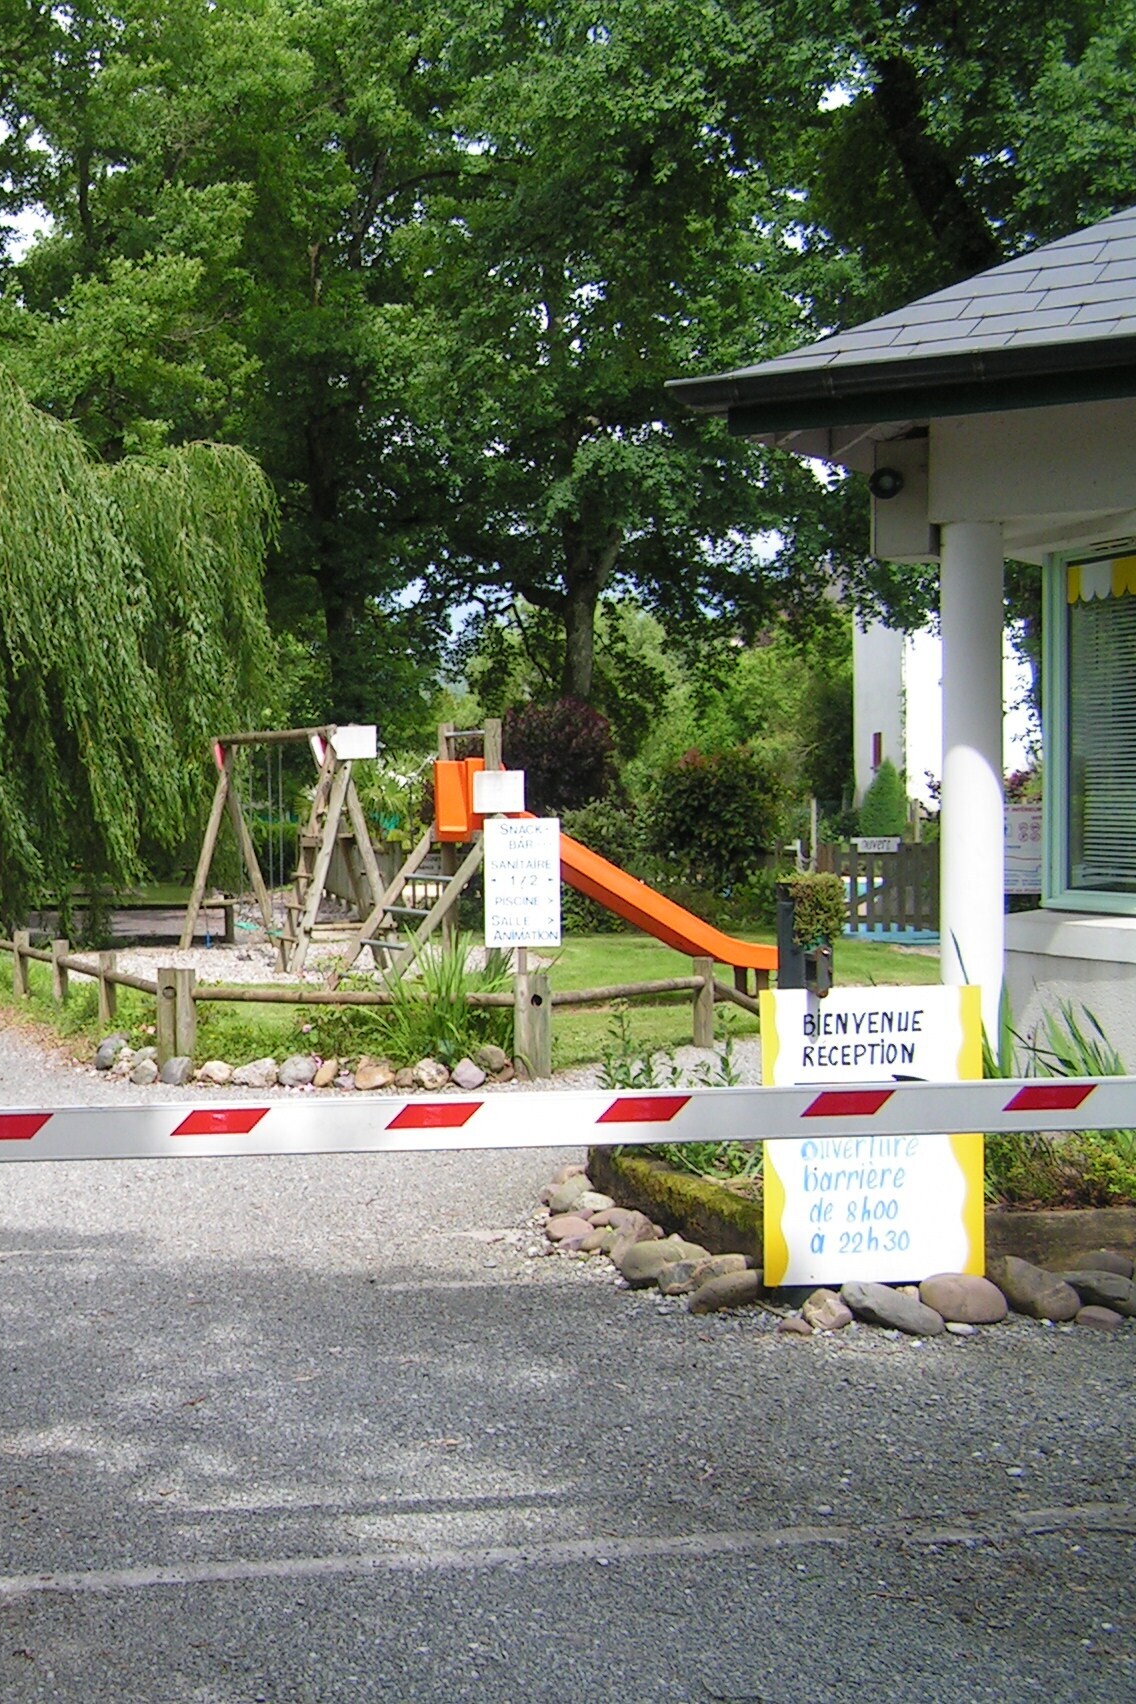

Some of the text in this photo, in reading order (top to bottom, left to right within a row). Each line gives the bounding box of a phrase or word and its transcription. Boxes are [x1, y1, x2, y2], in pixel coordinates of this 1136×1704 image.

[509, 839, 533, 850] BAR
[491, 859, 551, 870] SANITAIRE
[495, 896, 539, 906] PISCINE
[491, 914, 530, 927] SALLE
[493, 930, 559, 941] ANIMATION
[803, 1161, 906, 1192] barrière
[809, 1198, 833, 1223] de
[847, 1196, 899, 1223] 8h00
[838, 1227, 910, 1254] 22h30
